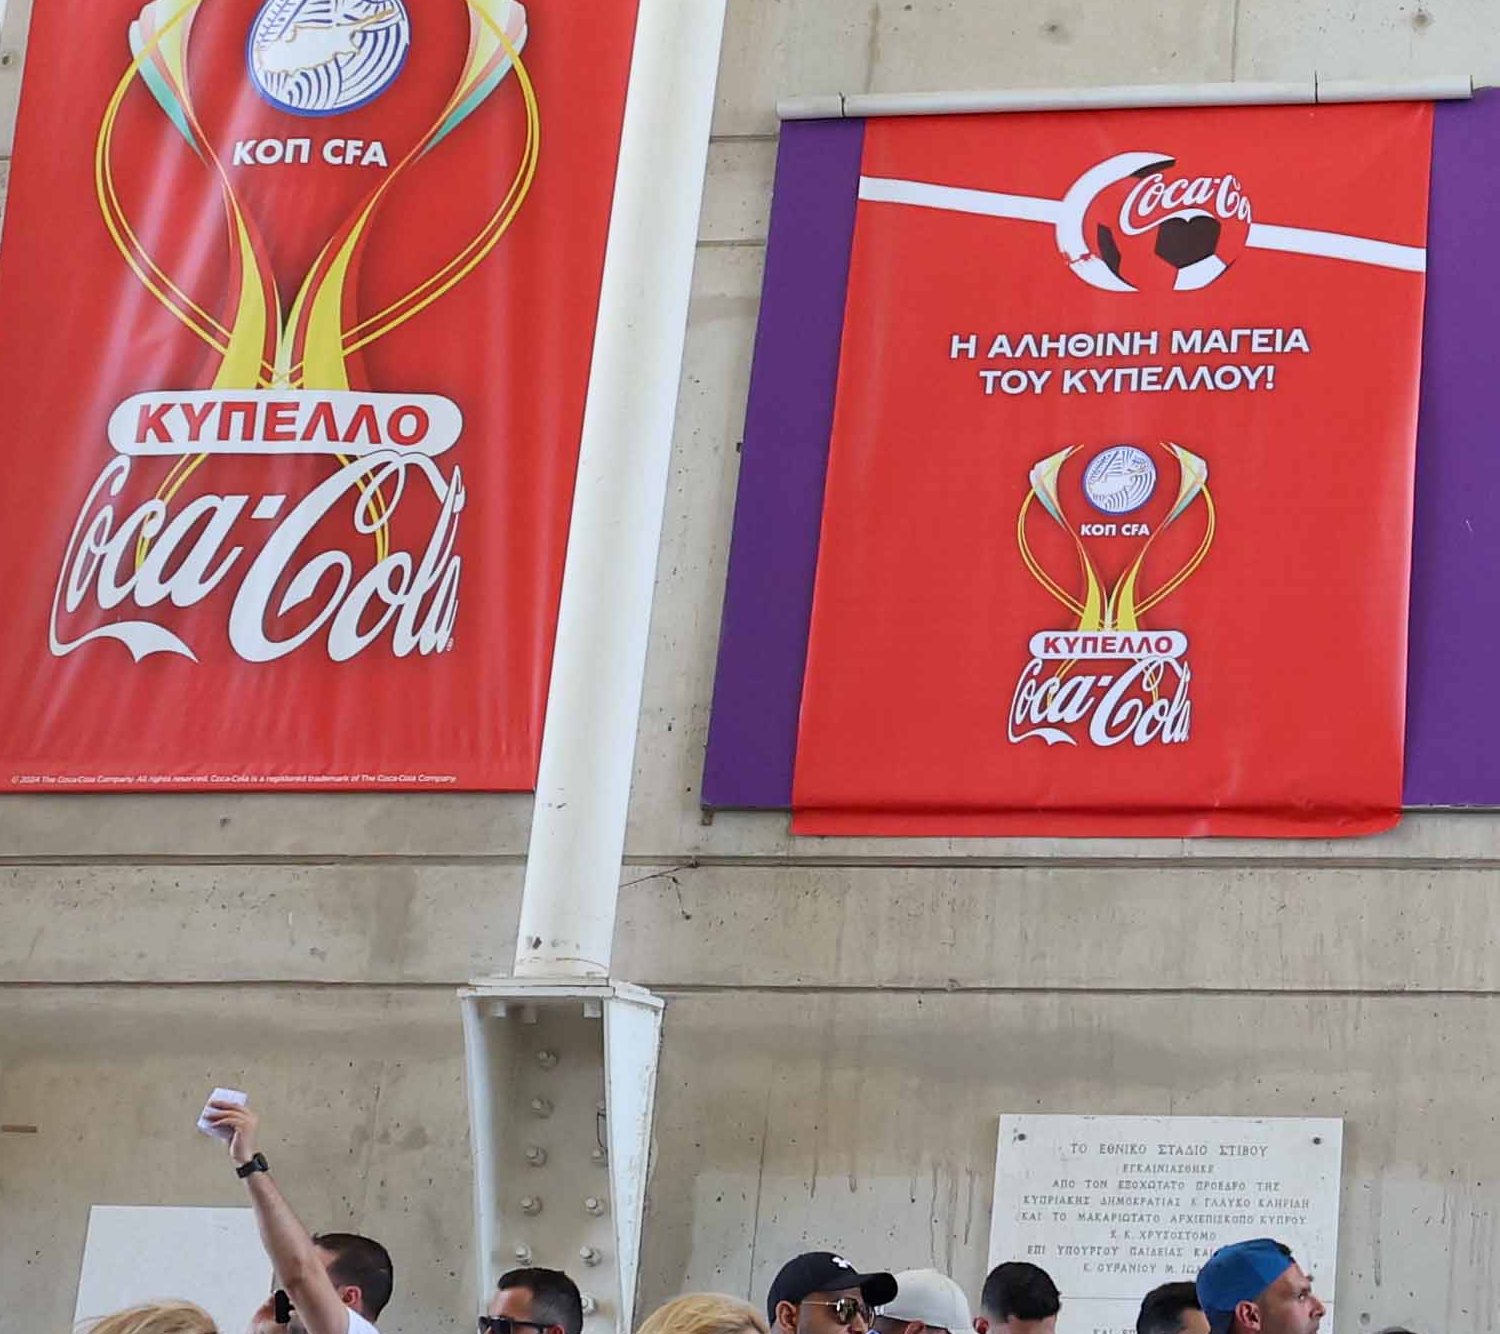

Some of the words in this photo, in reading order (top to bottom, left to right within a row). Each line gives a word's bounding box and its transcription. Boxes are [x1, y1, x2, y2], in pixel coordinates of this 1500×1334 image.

[231, 138, 311, 166] ΚΟΠ
[321, 138, 388, 167] CFA
[949, 334, 976, 360] Η
[988, 331, 1160, 359] ΑΛΗΘΙΝΗ
[1170, 327, 1310, 355] ΜΑΓΕΙΑ
[979, 368, 1052, 395] ΤΟΥ
[1061, 364, 1275, 395] ΚΥΠΕΛΛΟΥ!
[135, 402, 430, 445] ΚΥΠΕΛΛΟ
[1080, 523, 1116, 537] ΚΟΠ
[1121, 523, 1150, 536] CFA
[50, 449, 466, 663] Coca-Cola
[1042, 634, 1173, 655] ΚΥΠΕΛΛΟ
[1007, 656, 1190, 746] Coca-Cola
[1070, 1143, 1088, 1155] ΤΟ
[1100, 1143, 1147, 1155] ΕΘΝΙΚΟ
[1157, 1144, 1208, 1156] ΣΤΑΔΙΟ
[1219, 1144, 1269, 1157] ΣΤΙΒΟΥ
[1052, 1179, 1076, 1189] ΑΠΟ
[1084, 1179, 1108, 1189] ΤΟΝ
[1052, 1212, 1067, 1221] ΤΟ
